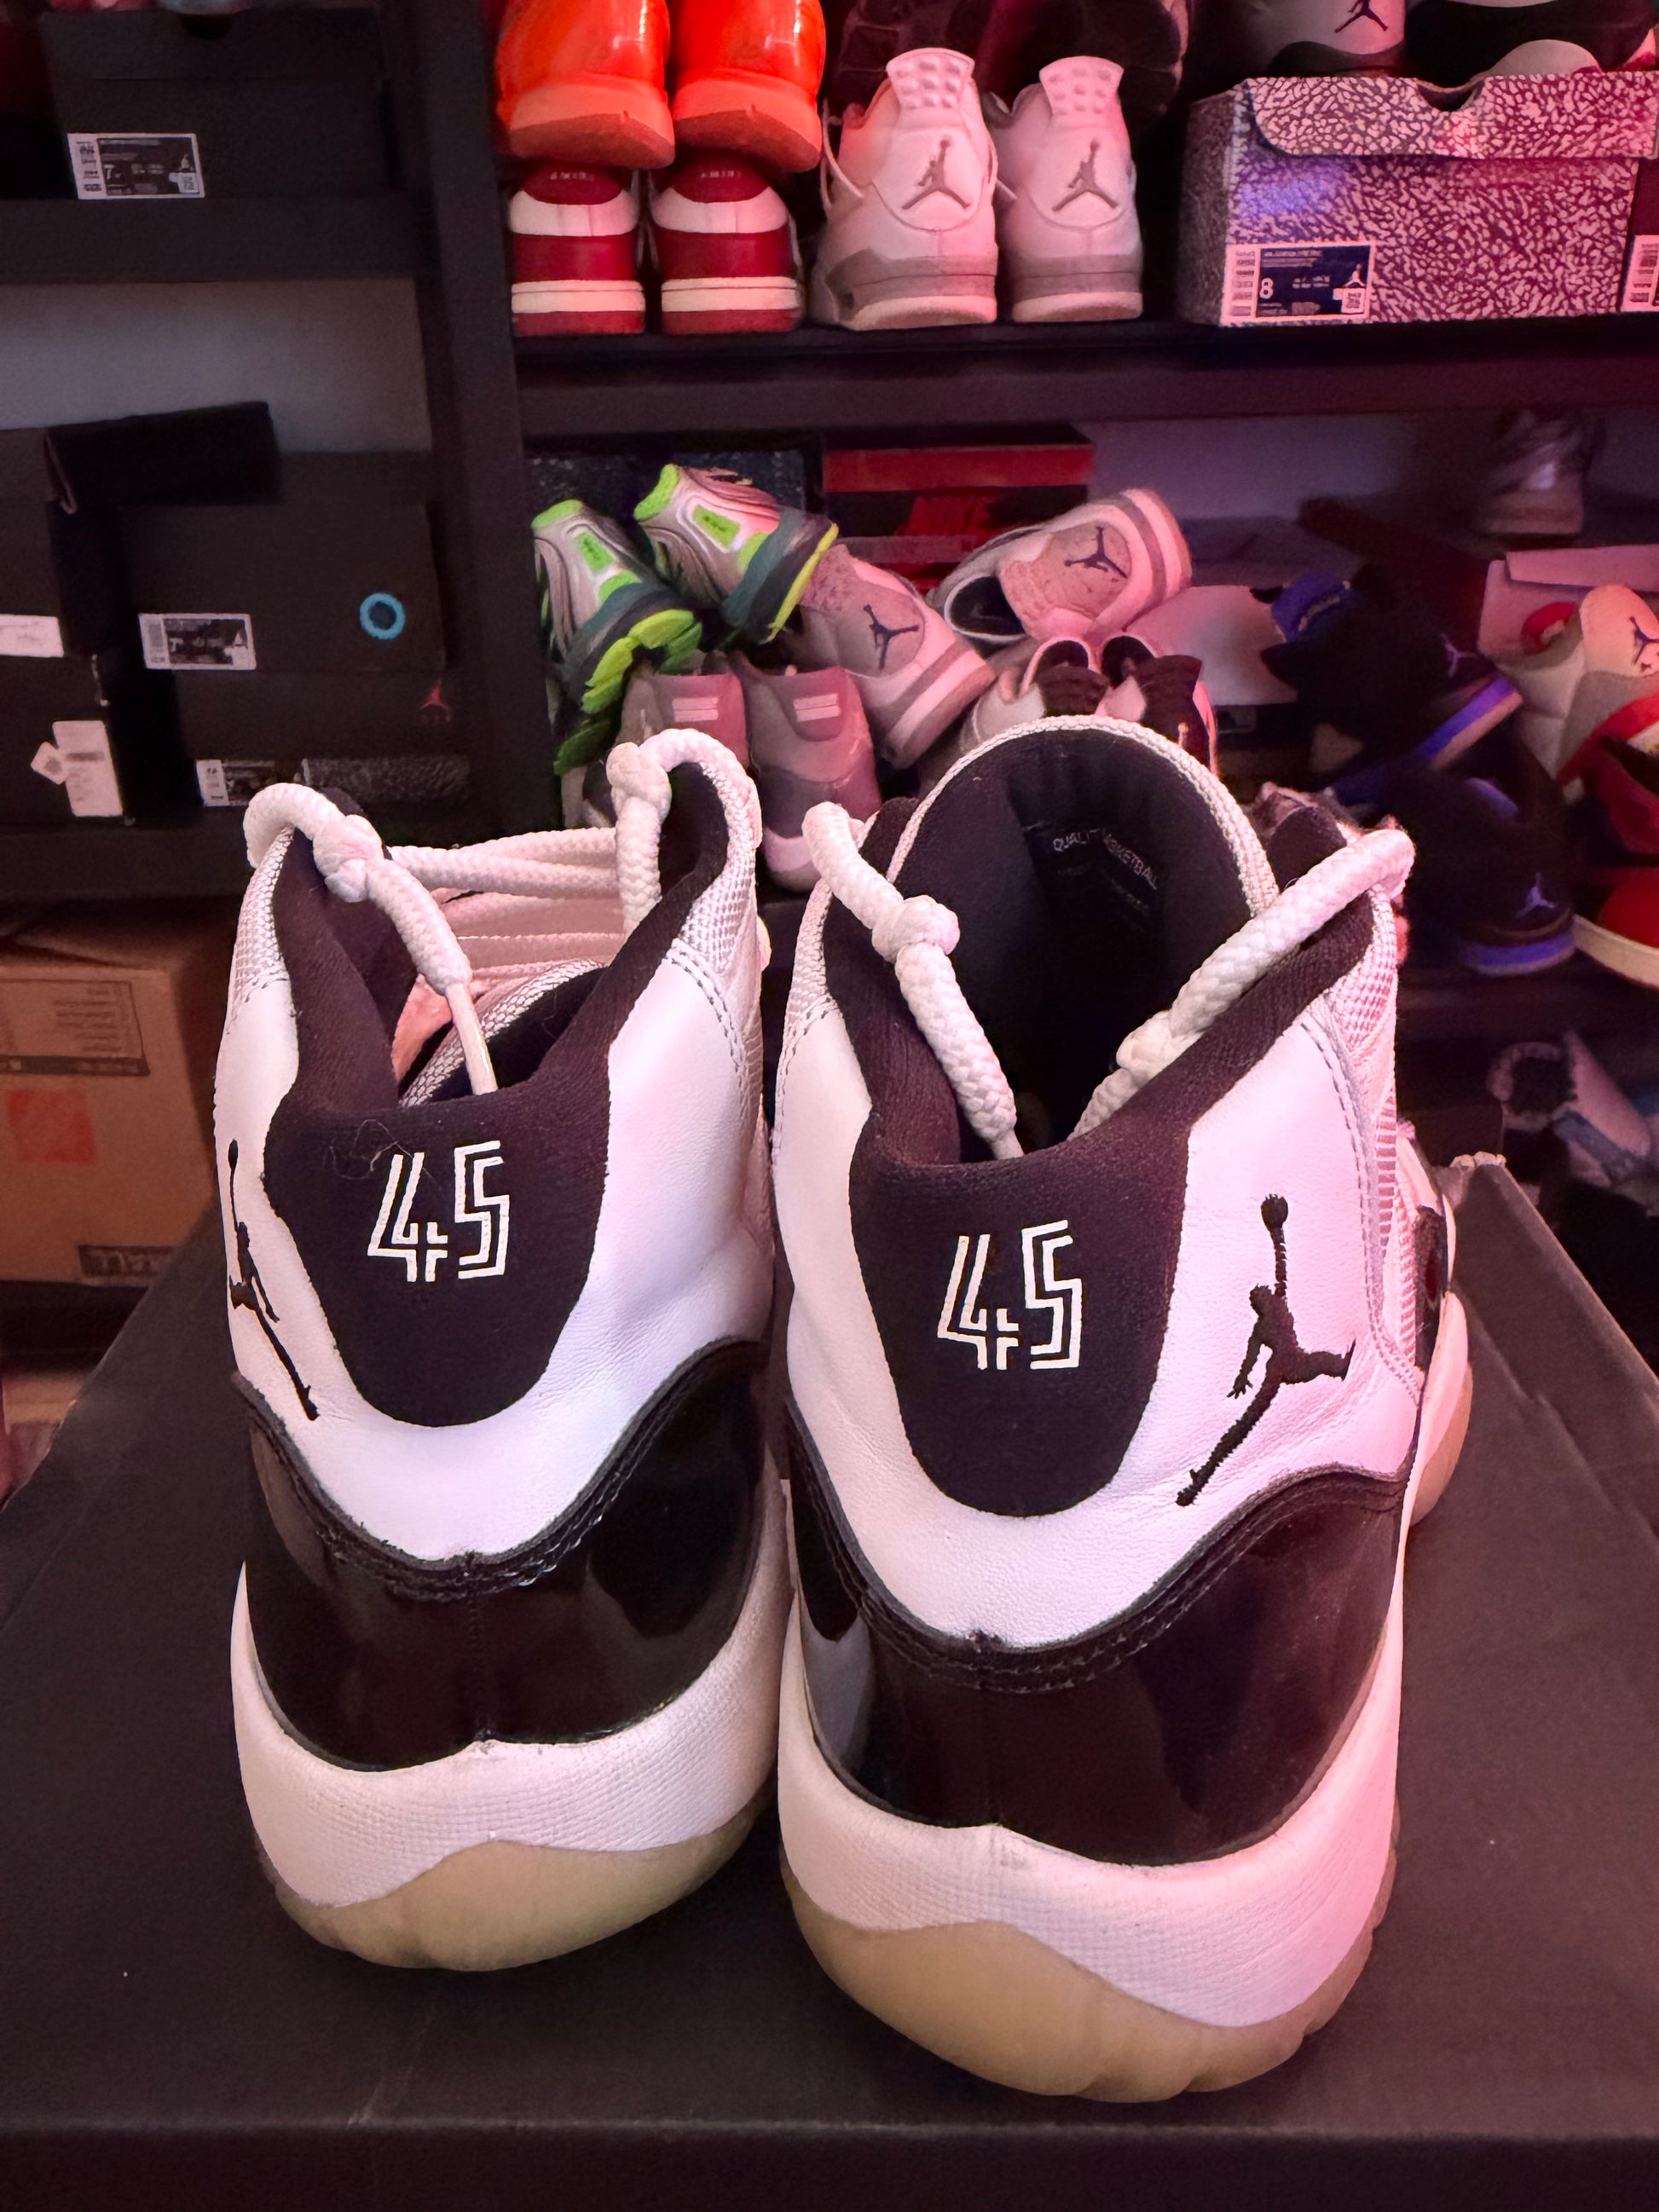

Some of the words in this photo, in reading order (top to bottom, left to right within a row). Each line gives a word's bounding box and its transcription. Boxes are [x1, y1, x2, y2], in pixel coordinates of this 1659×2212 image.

[1259, 277, 1274, 299] 8
[367, 1141, 510, 1282] 45
[937, 1219, 1083, 1370] 45
